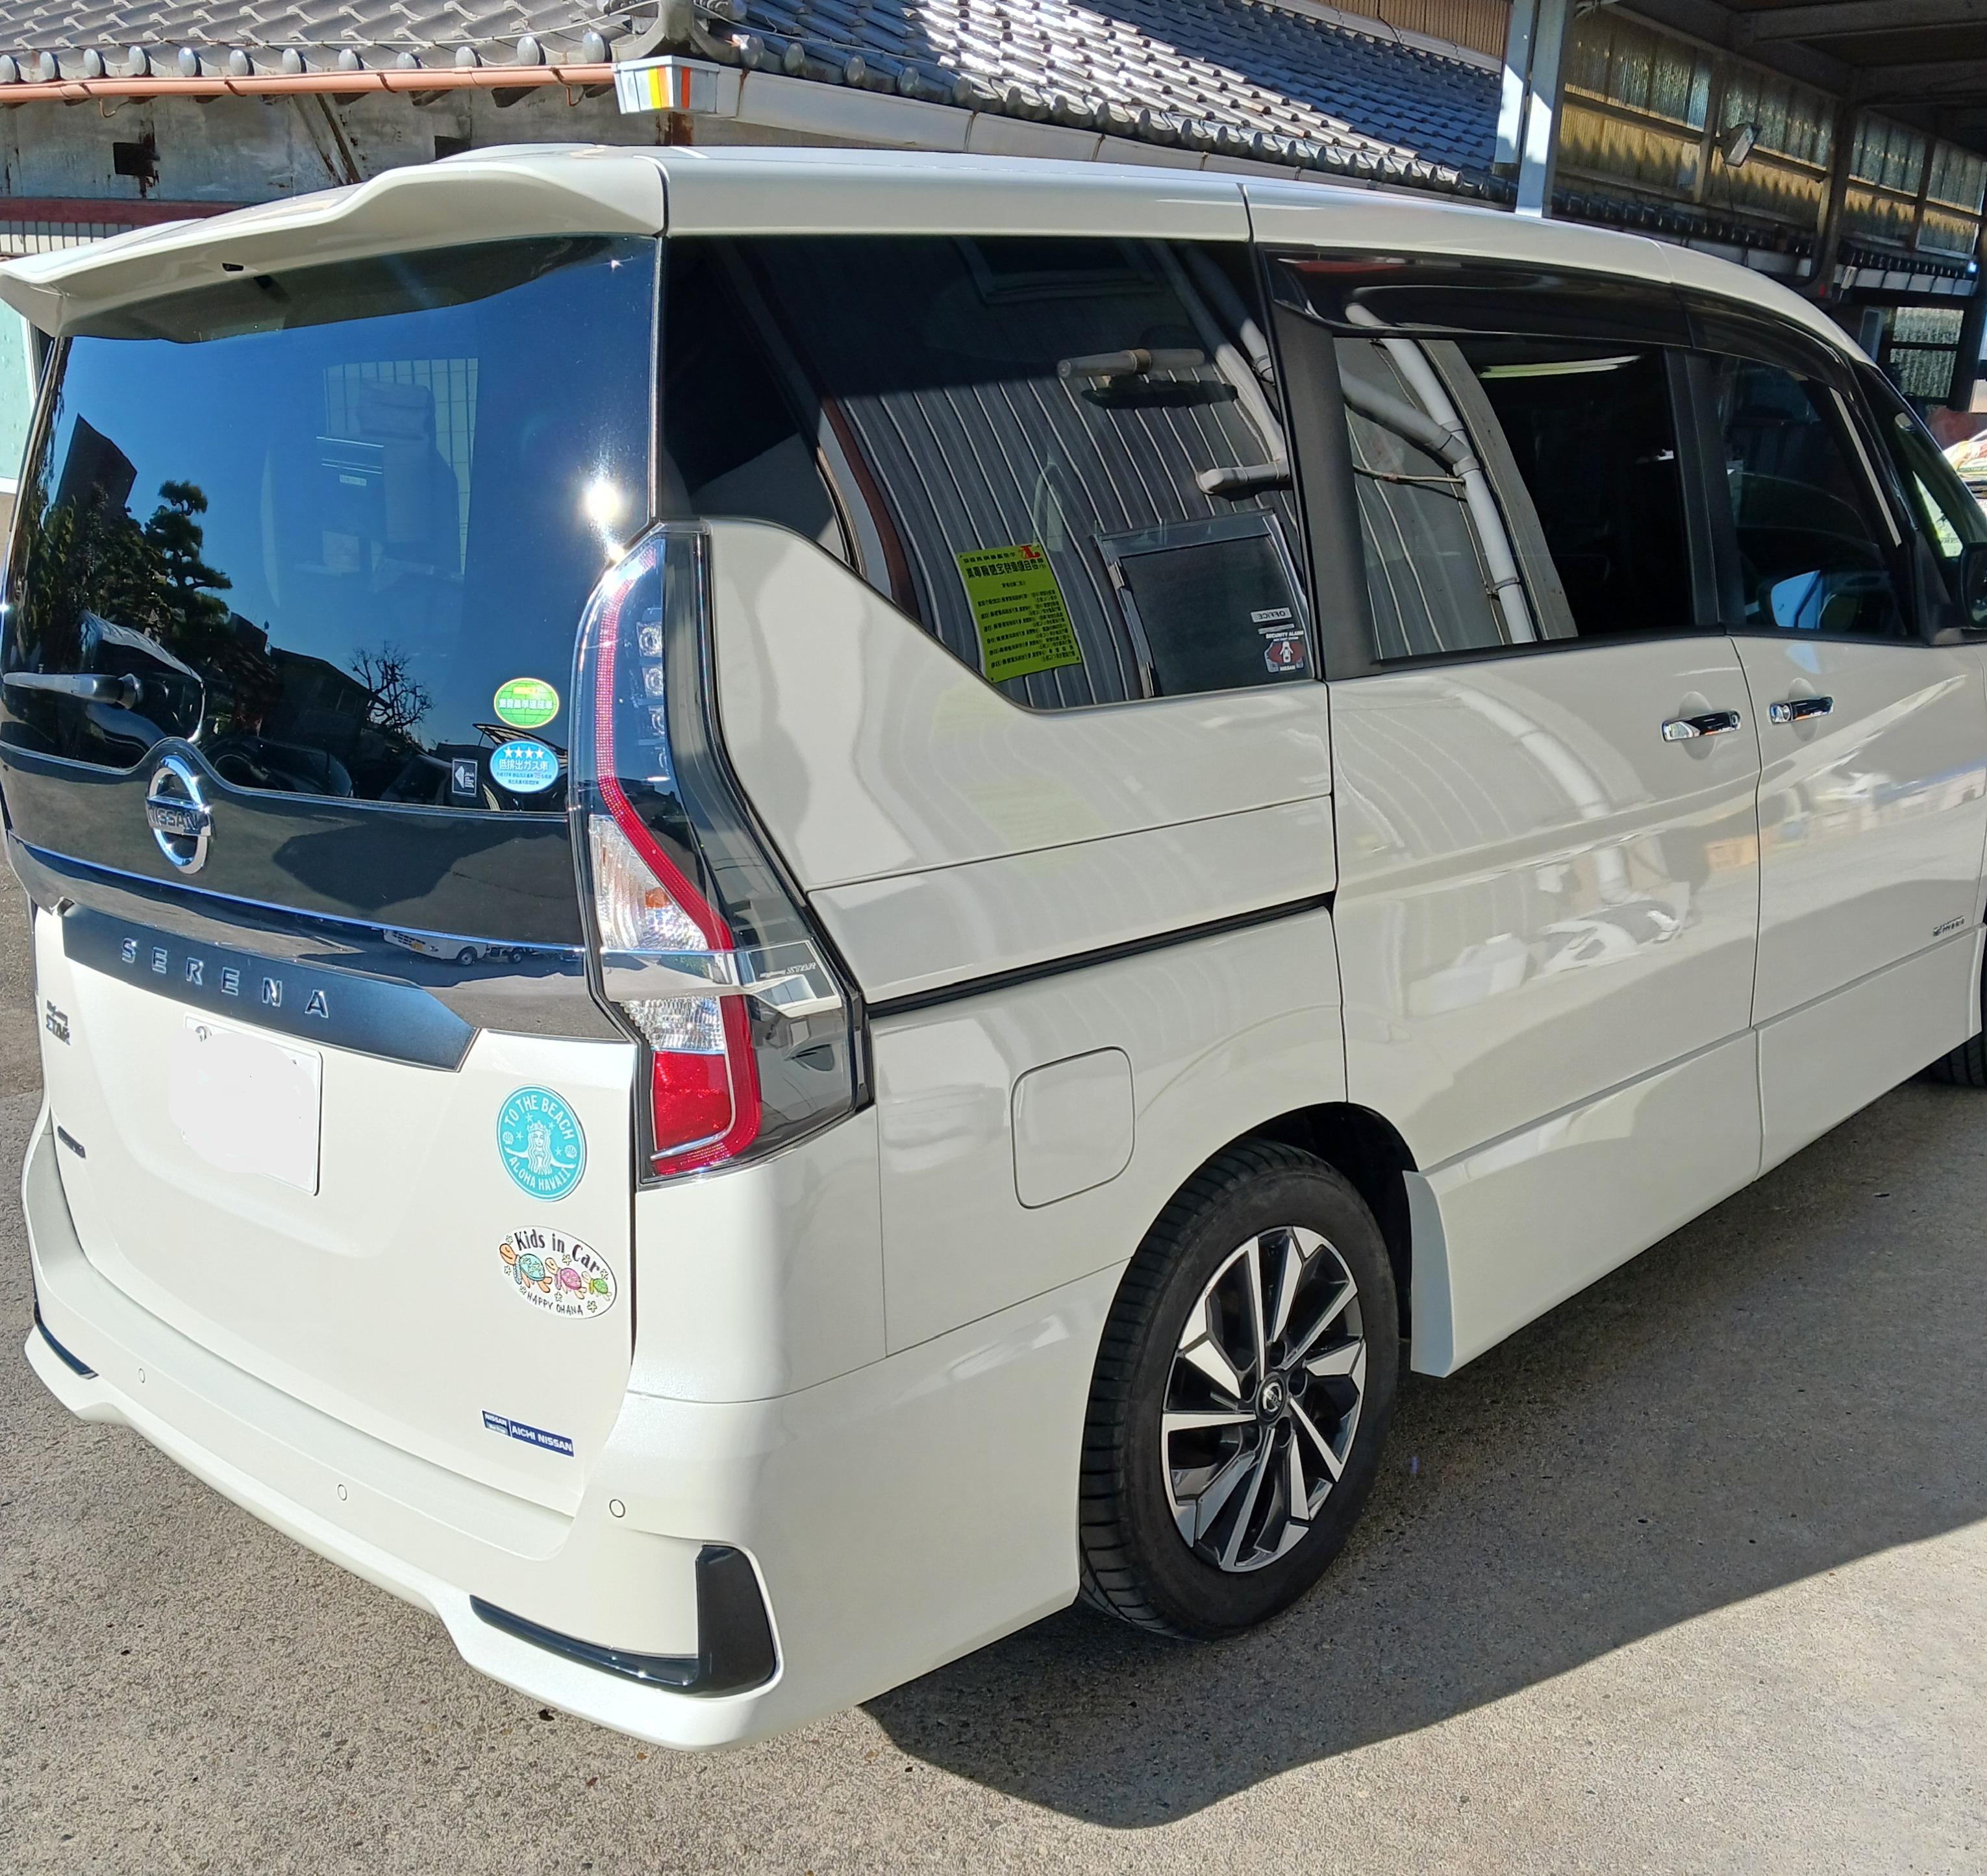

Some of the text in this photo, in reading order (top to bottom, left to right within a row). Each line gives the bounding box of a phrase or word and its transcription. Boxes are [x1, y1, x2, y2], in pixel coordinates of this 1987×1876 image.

[498, 758, 549, 772] 低排出ガス車
[147, 805, 198, 831] NISSAN
[121, 938, 329, 1018] SERENA
[504, 1095, 575, 1140] TO THE BEACH
[508, 1157, 571, 1191] ALOHA HAWAII
[514, 1229, 600, 1273] Kids in Car
[527, 1292, 584, 1316] HAPPY OHANA
[484, 1413, 507, 1427] NISSAN
[512, 1425, 536, 1440] AICHI
[538, 1434, 573, 1453] NISSAN
